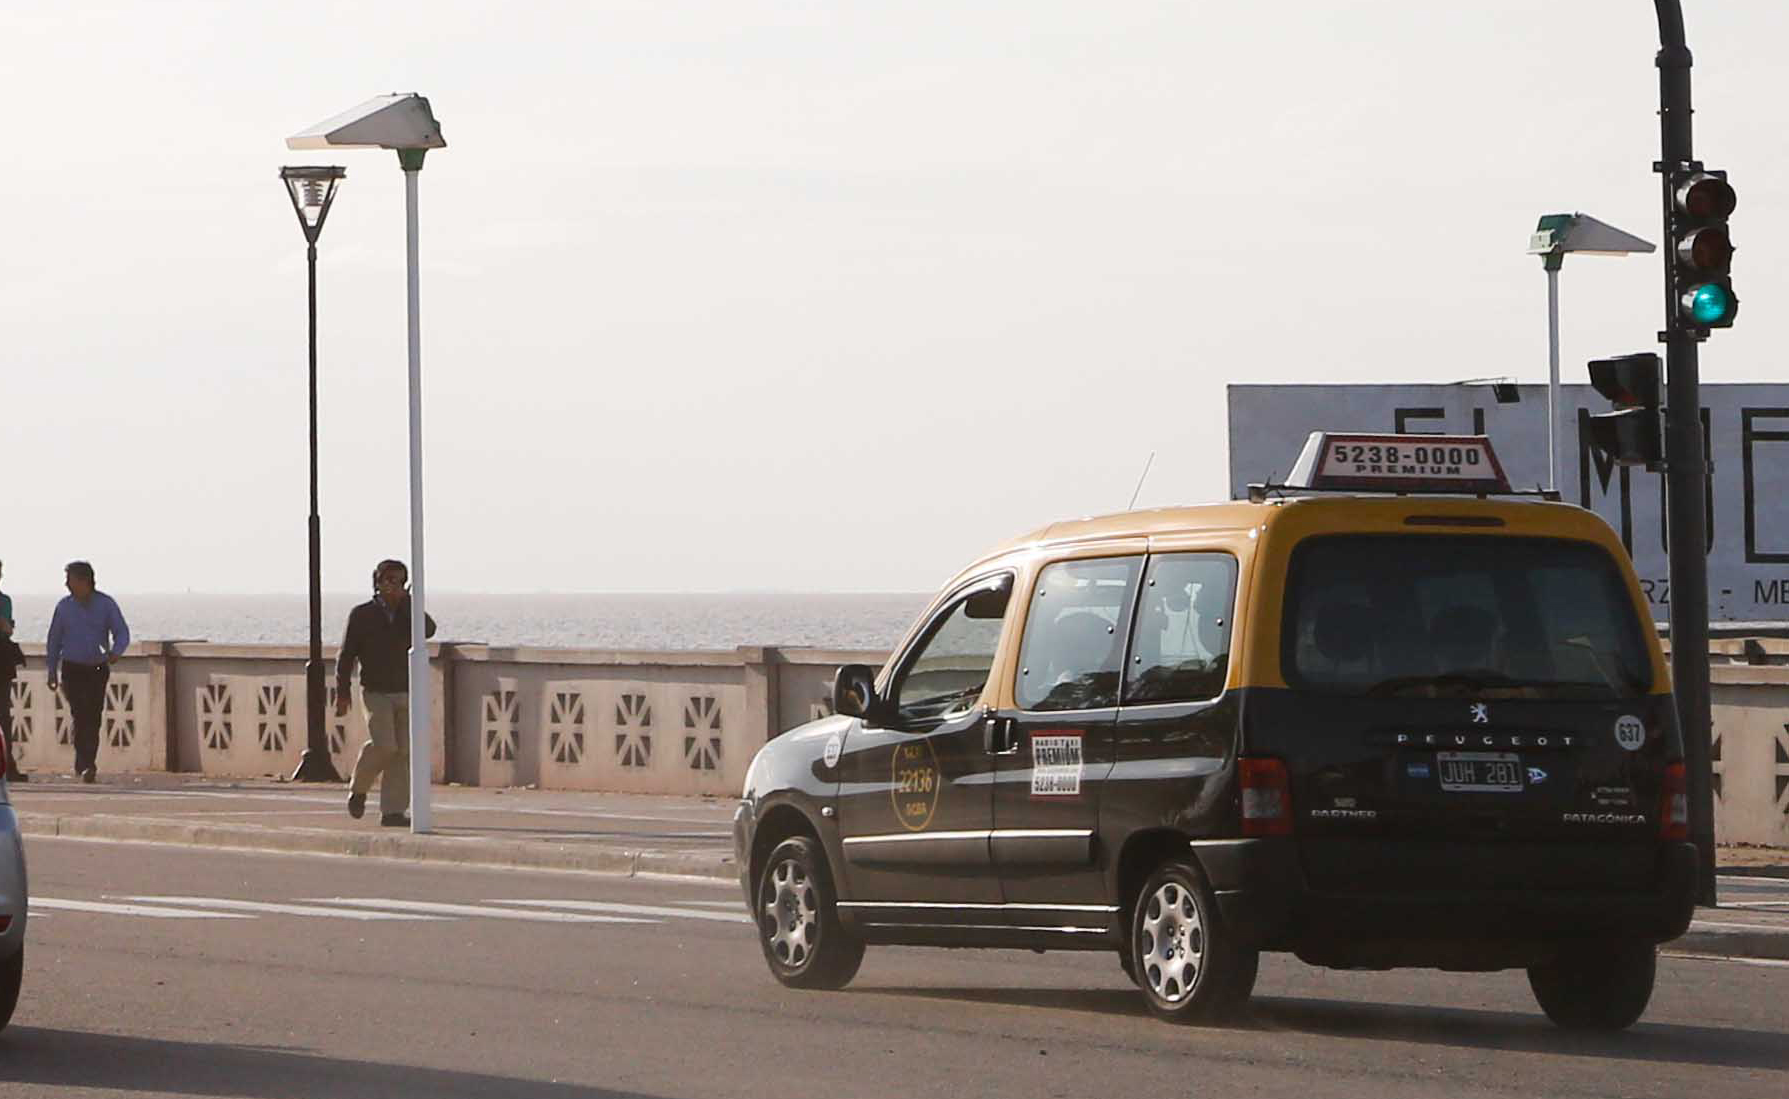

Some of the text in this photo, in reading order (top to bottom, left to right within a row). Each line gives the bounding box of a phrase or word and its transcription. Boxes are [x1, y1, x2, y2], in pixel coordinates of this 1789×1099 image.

[1334, 445, 1480, 465] 5238-0000
[1355, 464, 1461, 475] PREMIUM
[1397, 733, 1574, 746] PEUGEOT
[1619, 723, 1640, 742] 637
[1036, 747, 1081, 766] PREMIUM
[898, 766, 933, 794] 22136
[1443, 762, 1476, 783] JUH
[1486, 762, 1520, 784] 281
[1310, 809, 1378, 819] PARTNER
[1561, 811, 1647, 826] PATAGÓNICA
